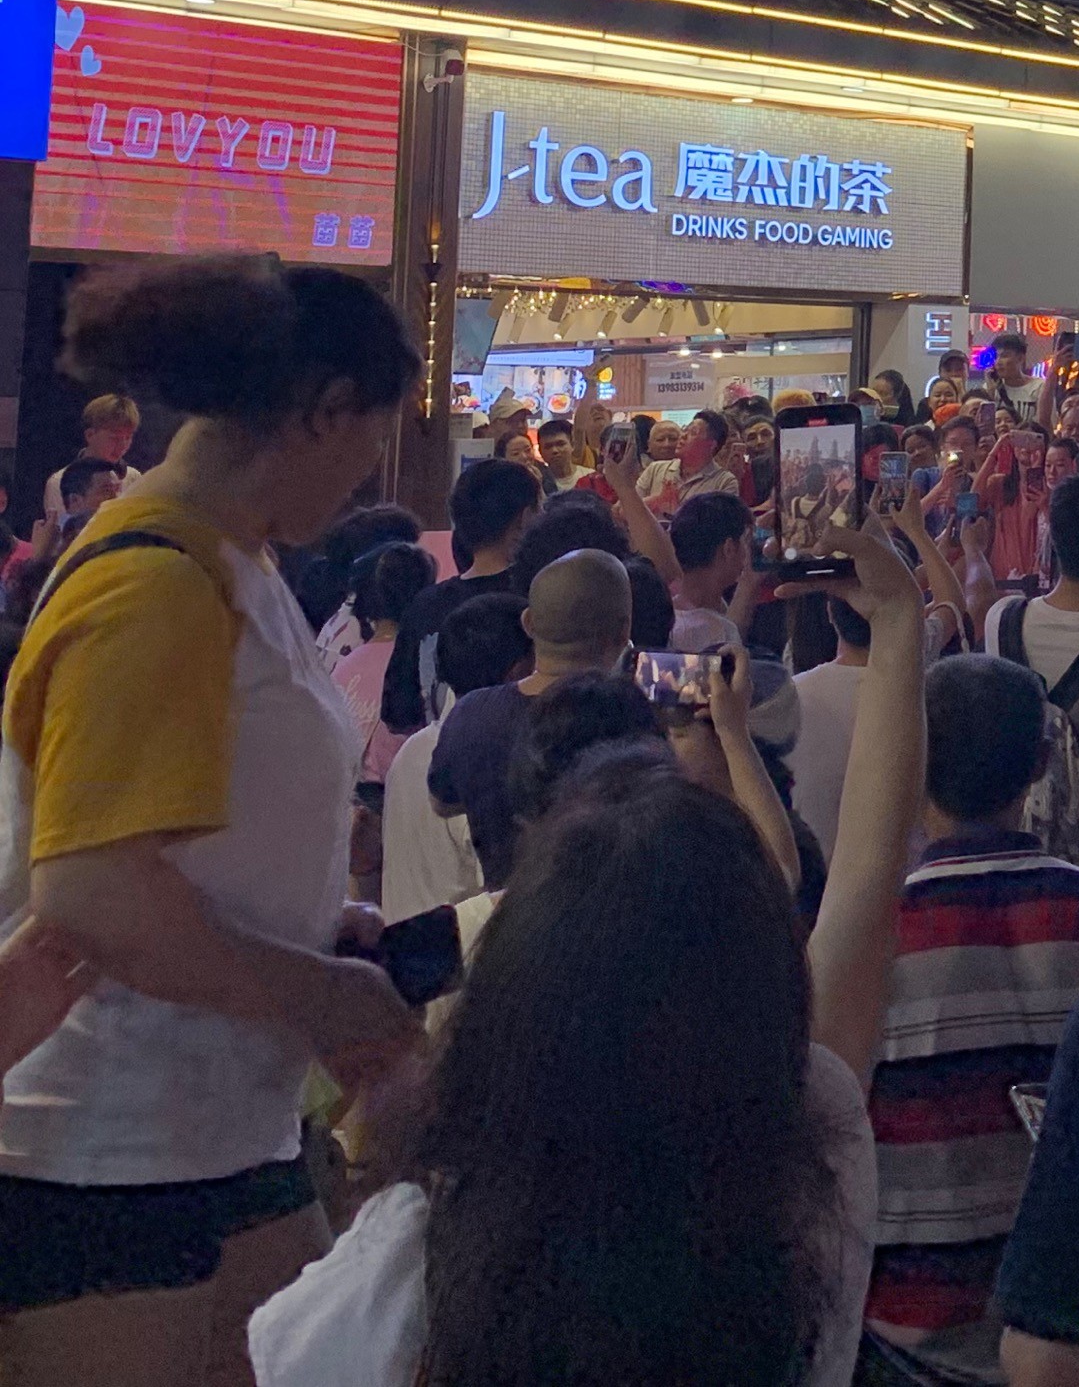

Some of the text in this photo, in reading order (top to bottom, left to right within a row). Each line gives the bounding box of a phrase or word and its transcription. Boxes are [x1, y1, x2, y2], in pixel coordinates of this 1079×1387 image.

[674, 143, 891, 214] 魔杰的茶
[672, 214, 893, 249] DRINKS FOOD GAMING
